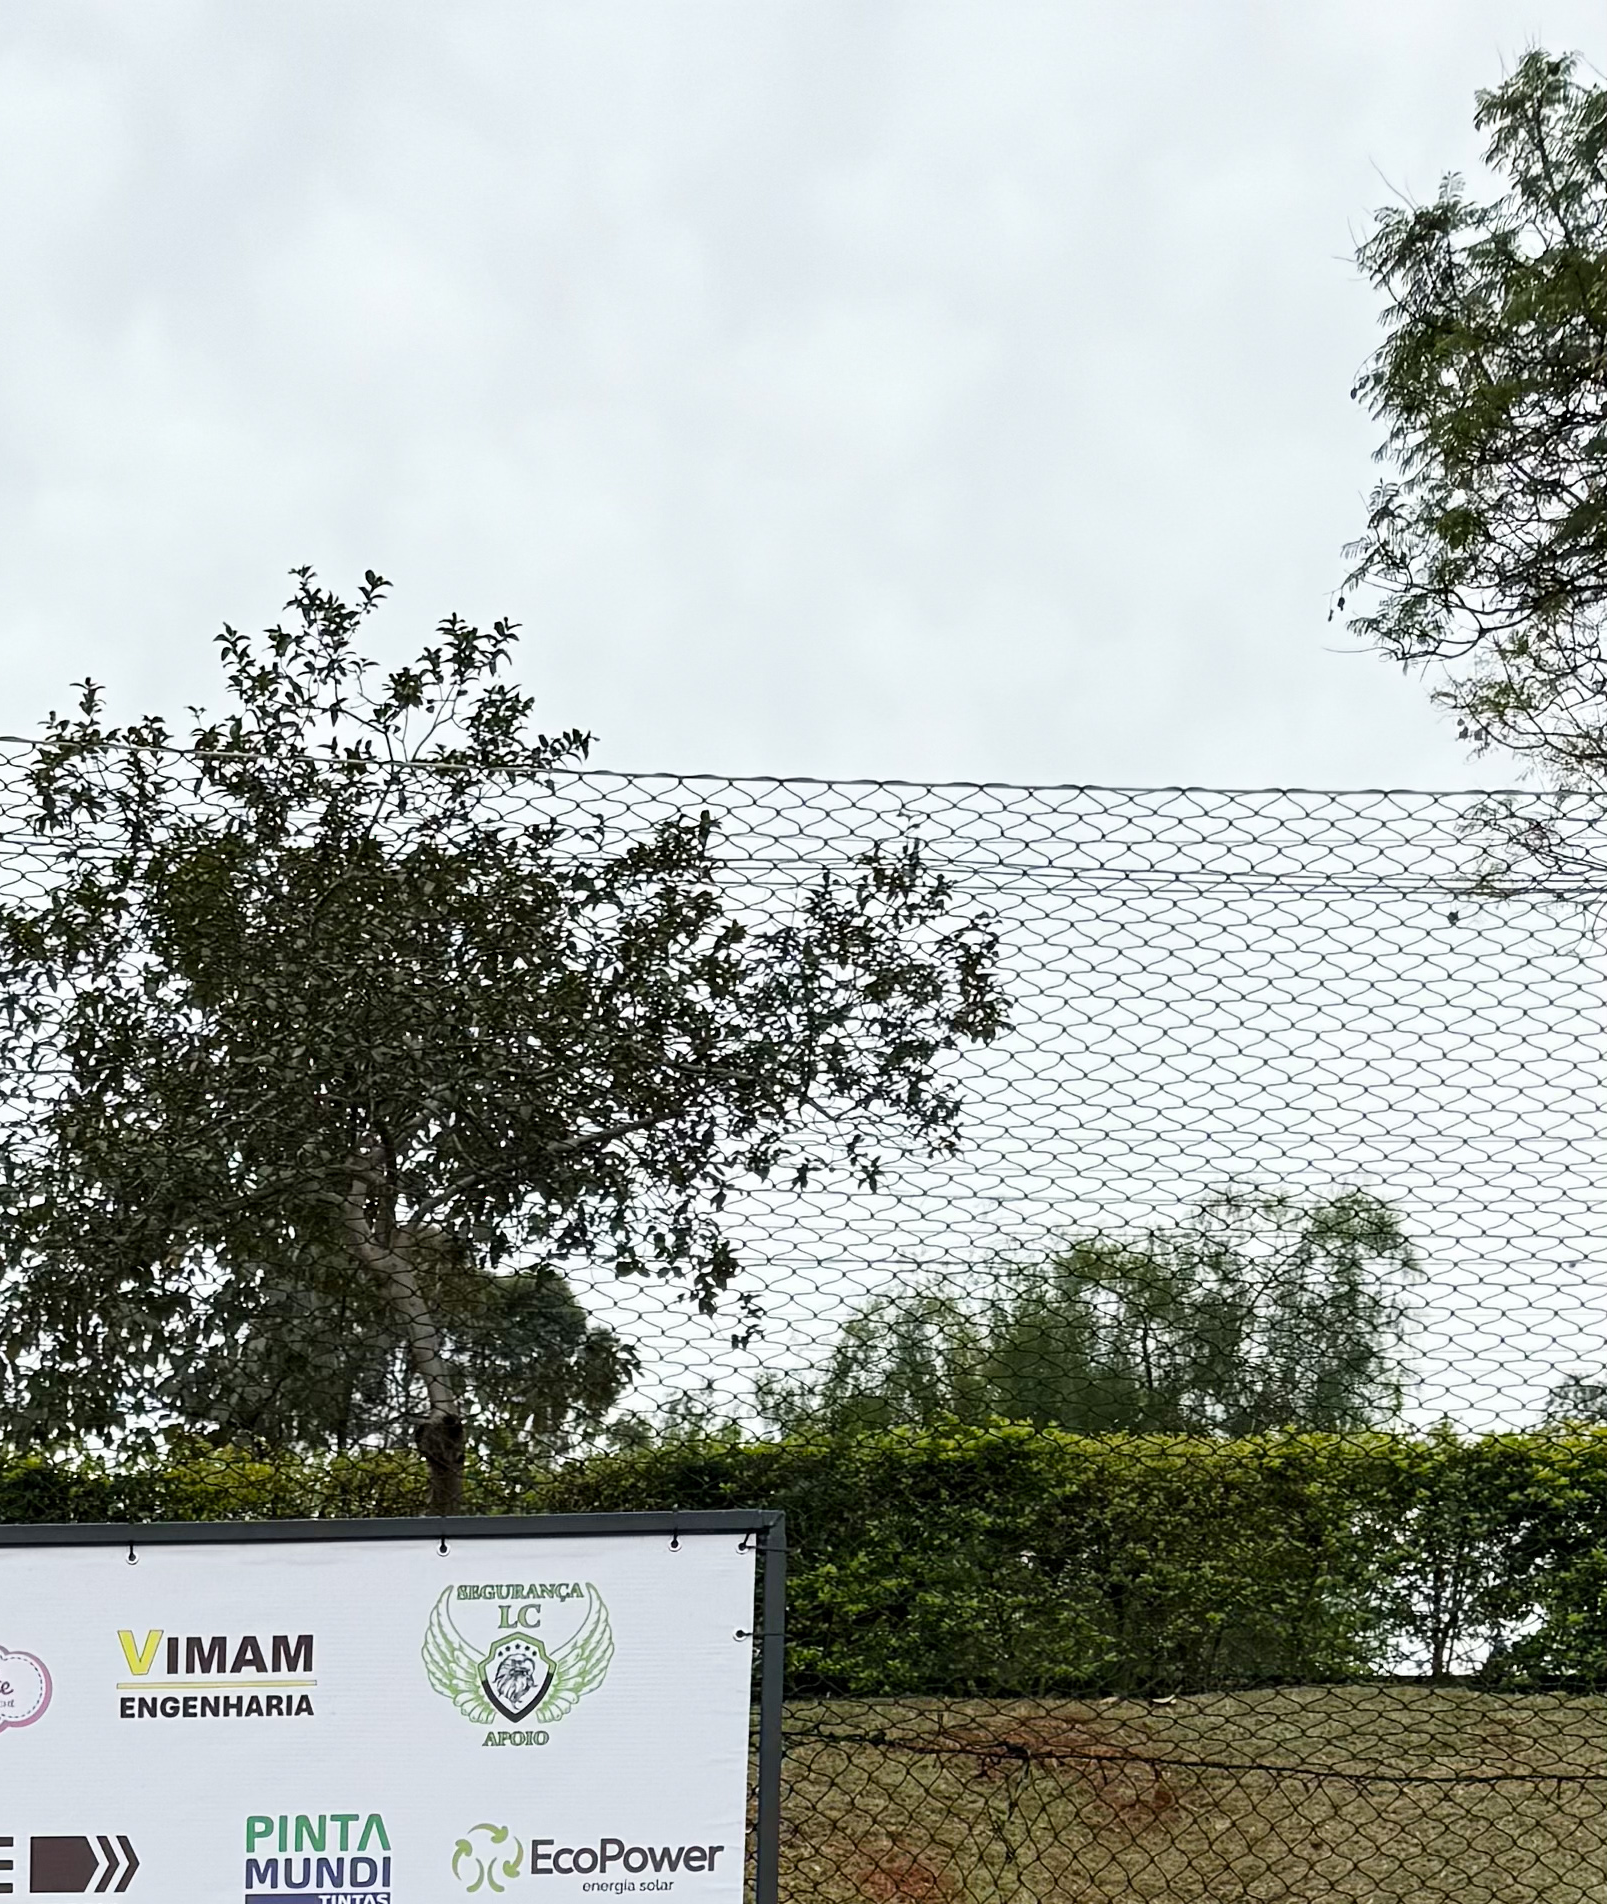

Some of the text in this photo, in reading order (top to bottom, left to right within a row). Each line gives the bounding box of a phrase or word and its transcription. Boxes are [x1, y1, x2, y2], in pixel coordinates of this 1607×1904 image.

[456, 1582, 585, 1602] SEGURANÇA
[497, 1603, 542, 1629] LC
[117, 1630, 314, 1676] VIMAM
[119, 1694, 314, 1719] ENGENHARIA
[482, 1730, 550, 1747] APOIO
[245, 1813, 392, 1853] PINTA
[530, 1838, 725, 1875] EcoPower
[245, 1856, 392, 1890] MUNDI
[582, 1878, 675, 1895] energia solar
